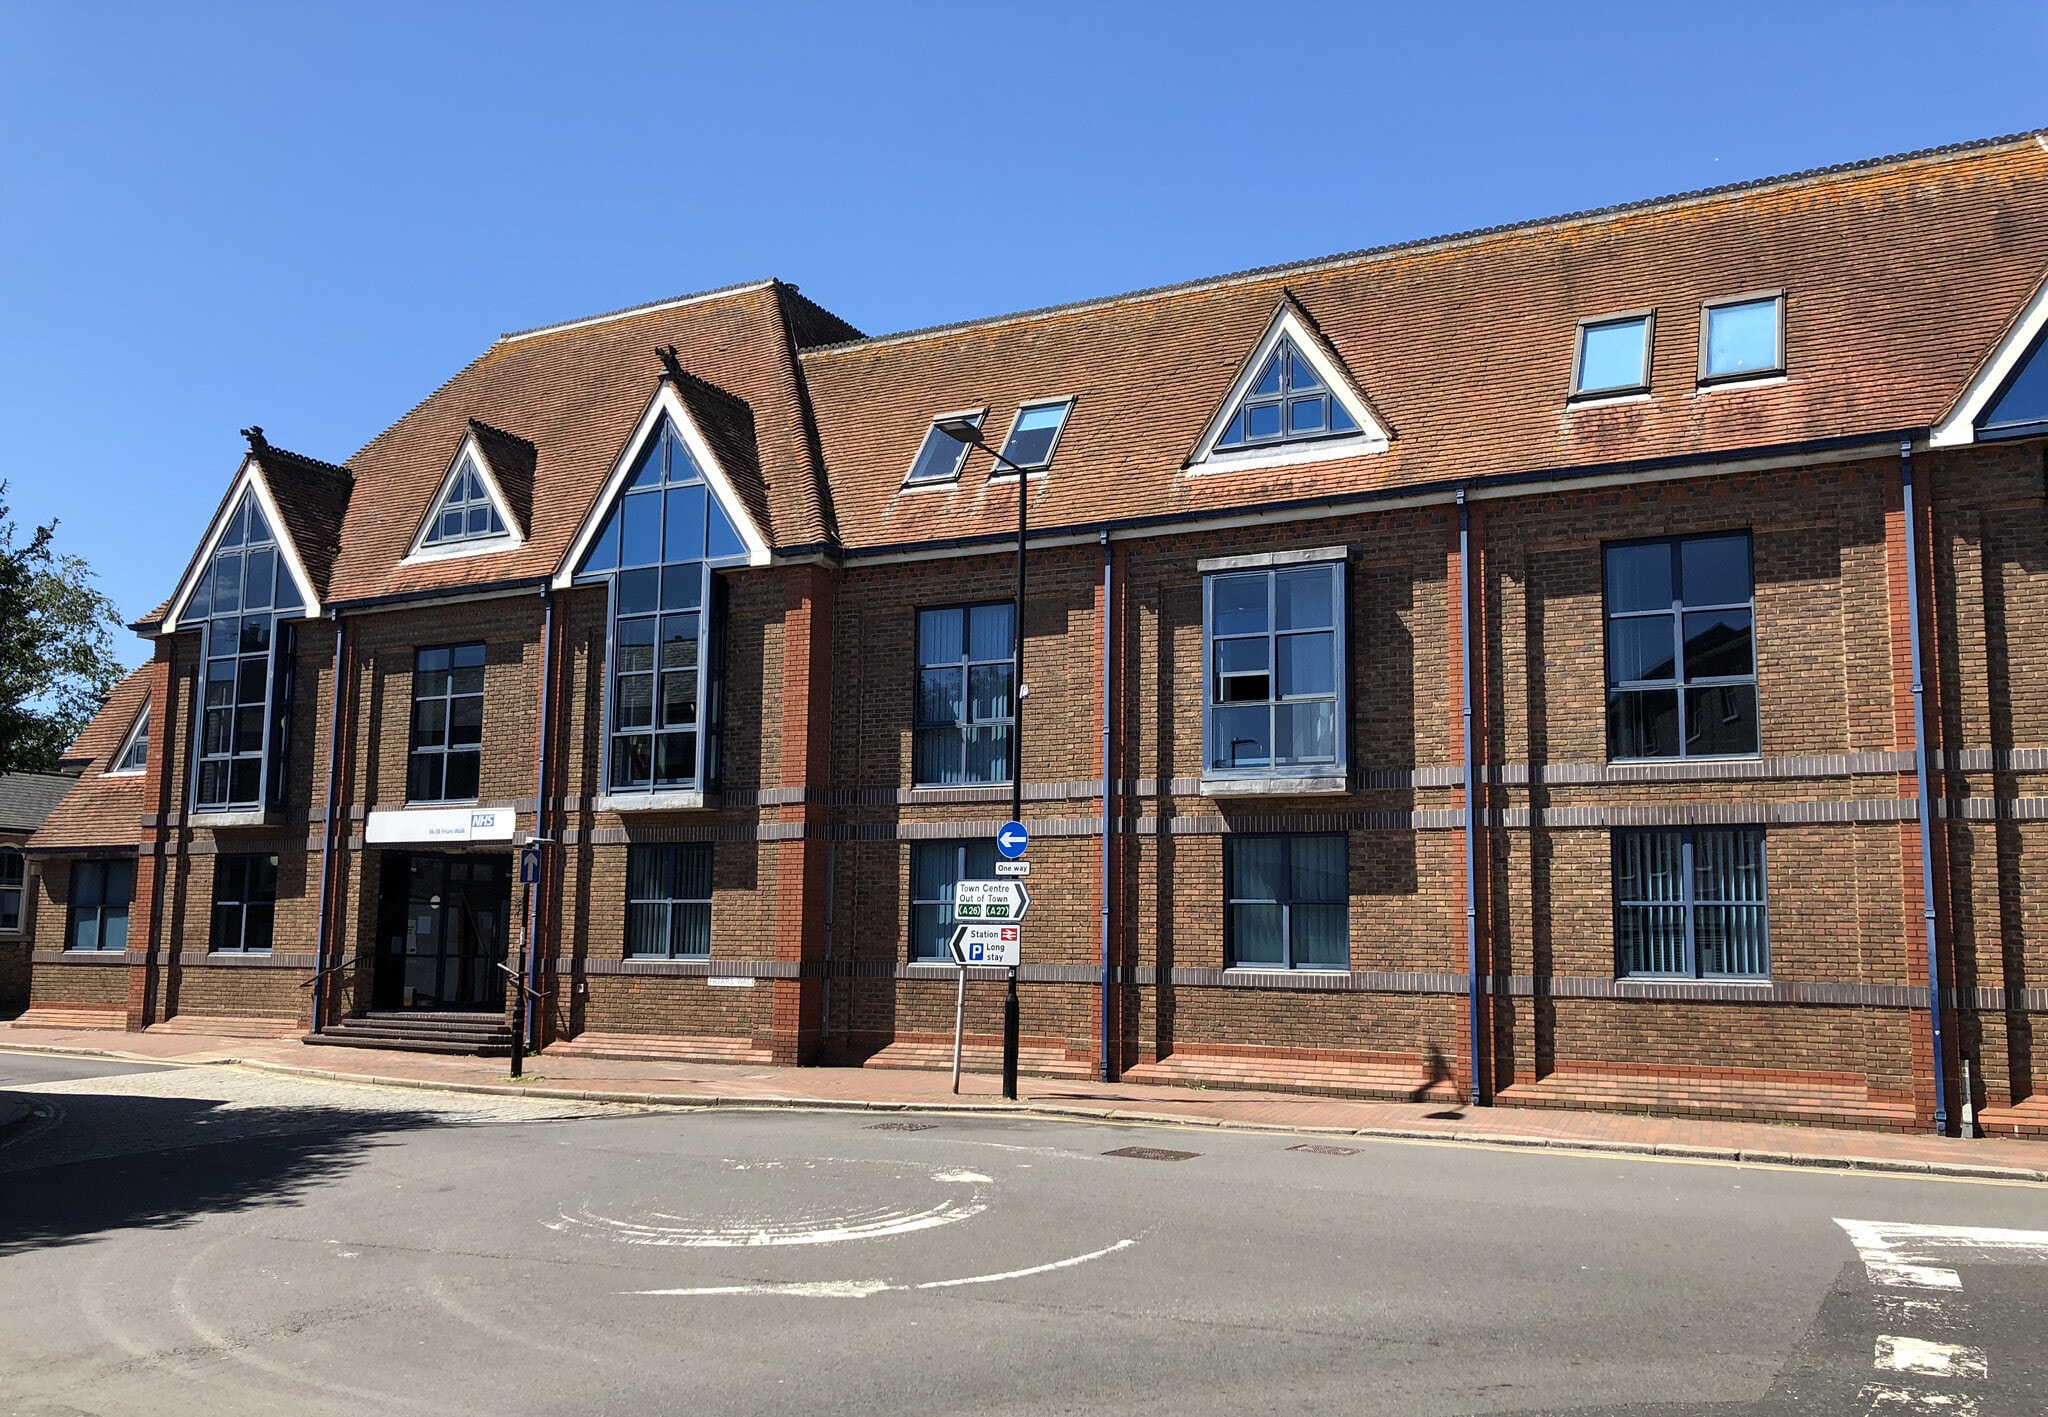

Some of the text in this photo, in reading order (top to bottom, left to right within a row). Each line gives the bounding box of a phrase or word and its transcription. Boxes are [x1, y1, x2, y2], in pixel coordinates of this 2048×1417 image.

[472, 815, 494, 826] NHS
[960, 884, 1010, 892] Town Centre
[960, 894, 1008, 902] Out of Town
[970, 930, 999, 938] Station
[986, 943, 1005, 952] Long
[987, 953, 1004, 962] stay
